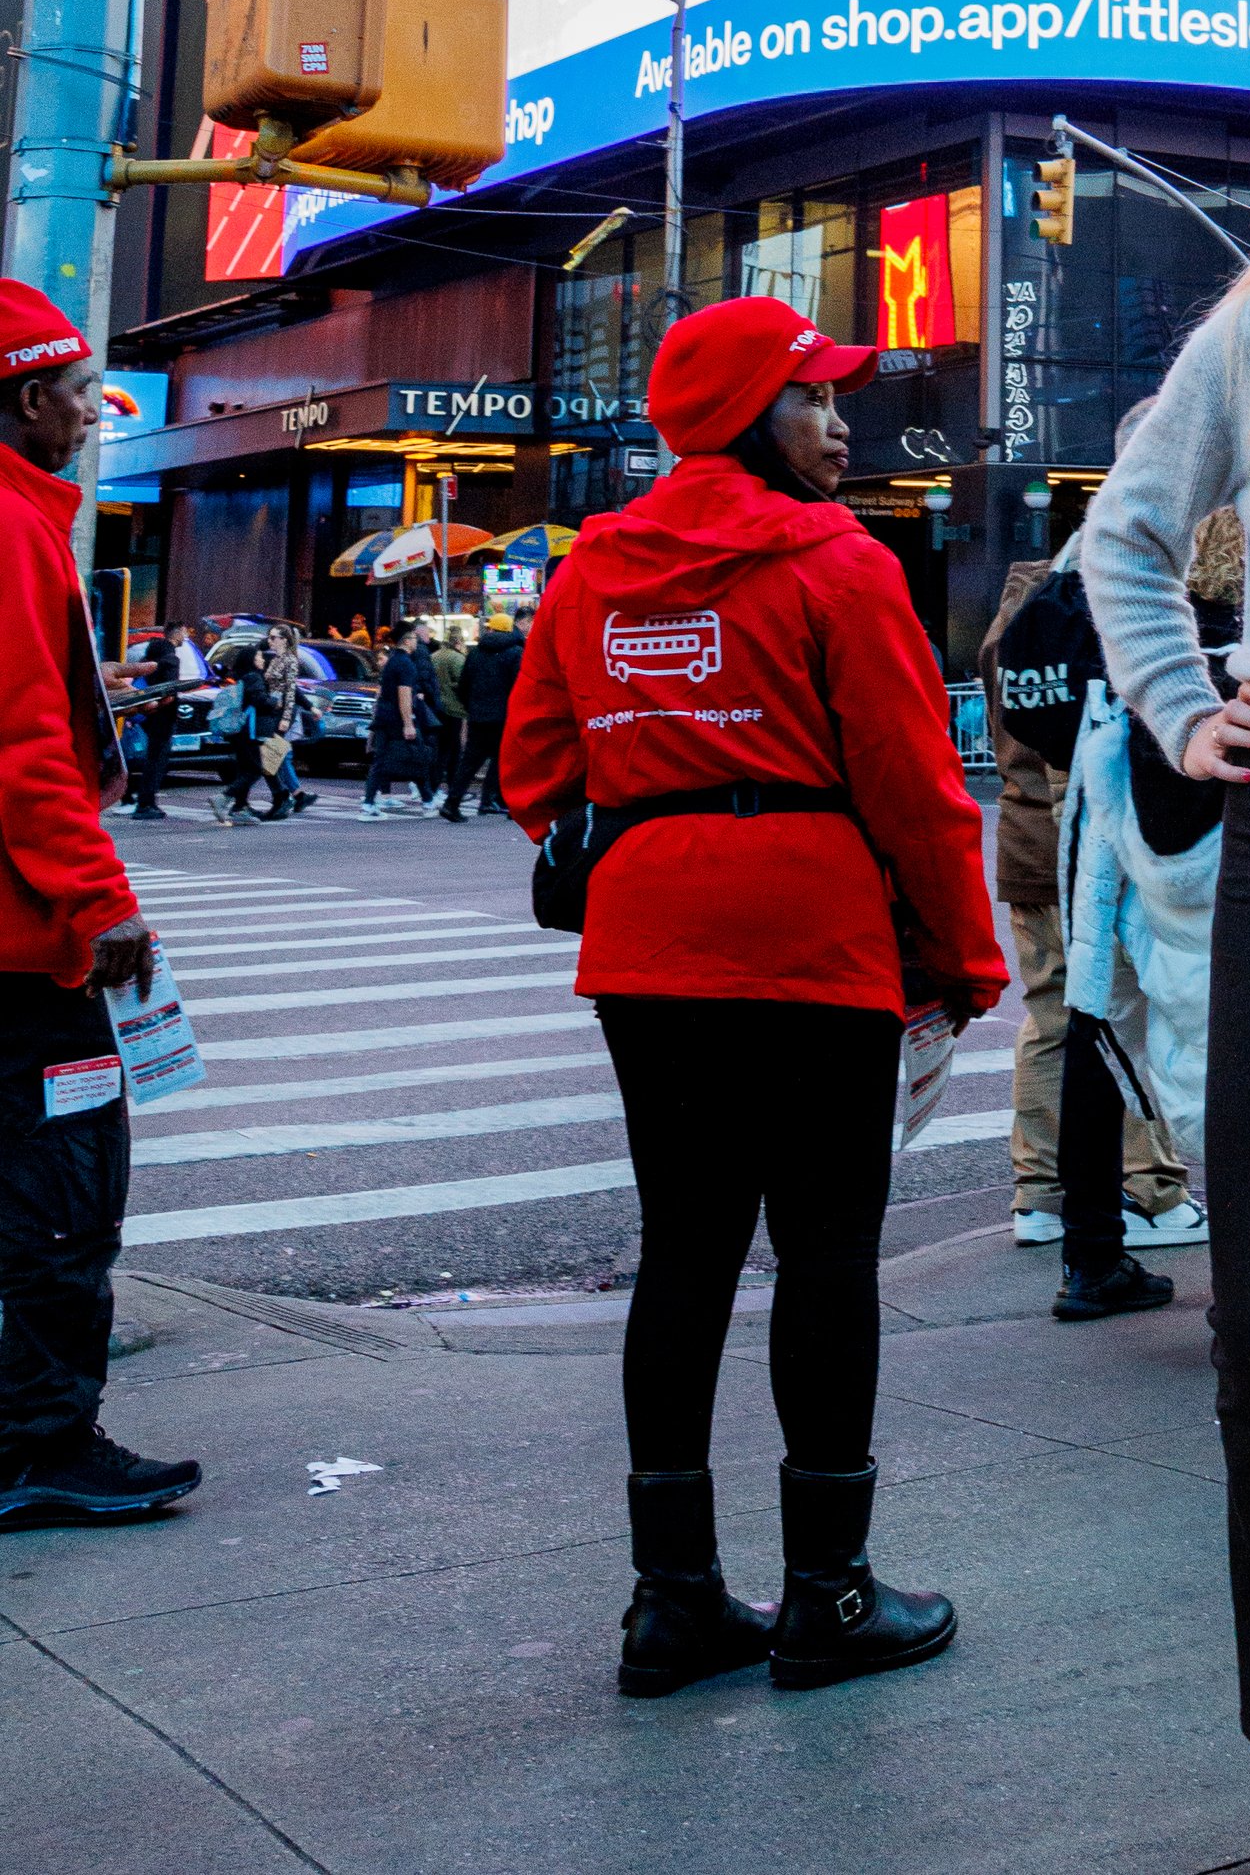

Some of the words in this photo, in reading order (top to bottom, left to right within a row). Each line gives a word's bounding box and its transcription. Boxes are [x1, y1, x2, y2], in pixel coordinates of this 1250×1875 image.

[634, 20, 752, 98] Avalable
[760, 18, 810, 59] on
[5, 336, 83, 367] TOPVIEW
[280, 396, 329, 438] TEMPO
[400, 384, 533, 425] TEMPO
[730, 708, 764, 723] OFF
